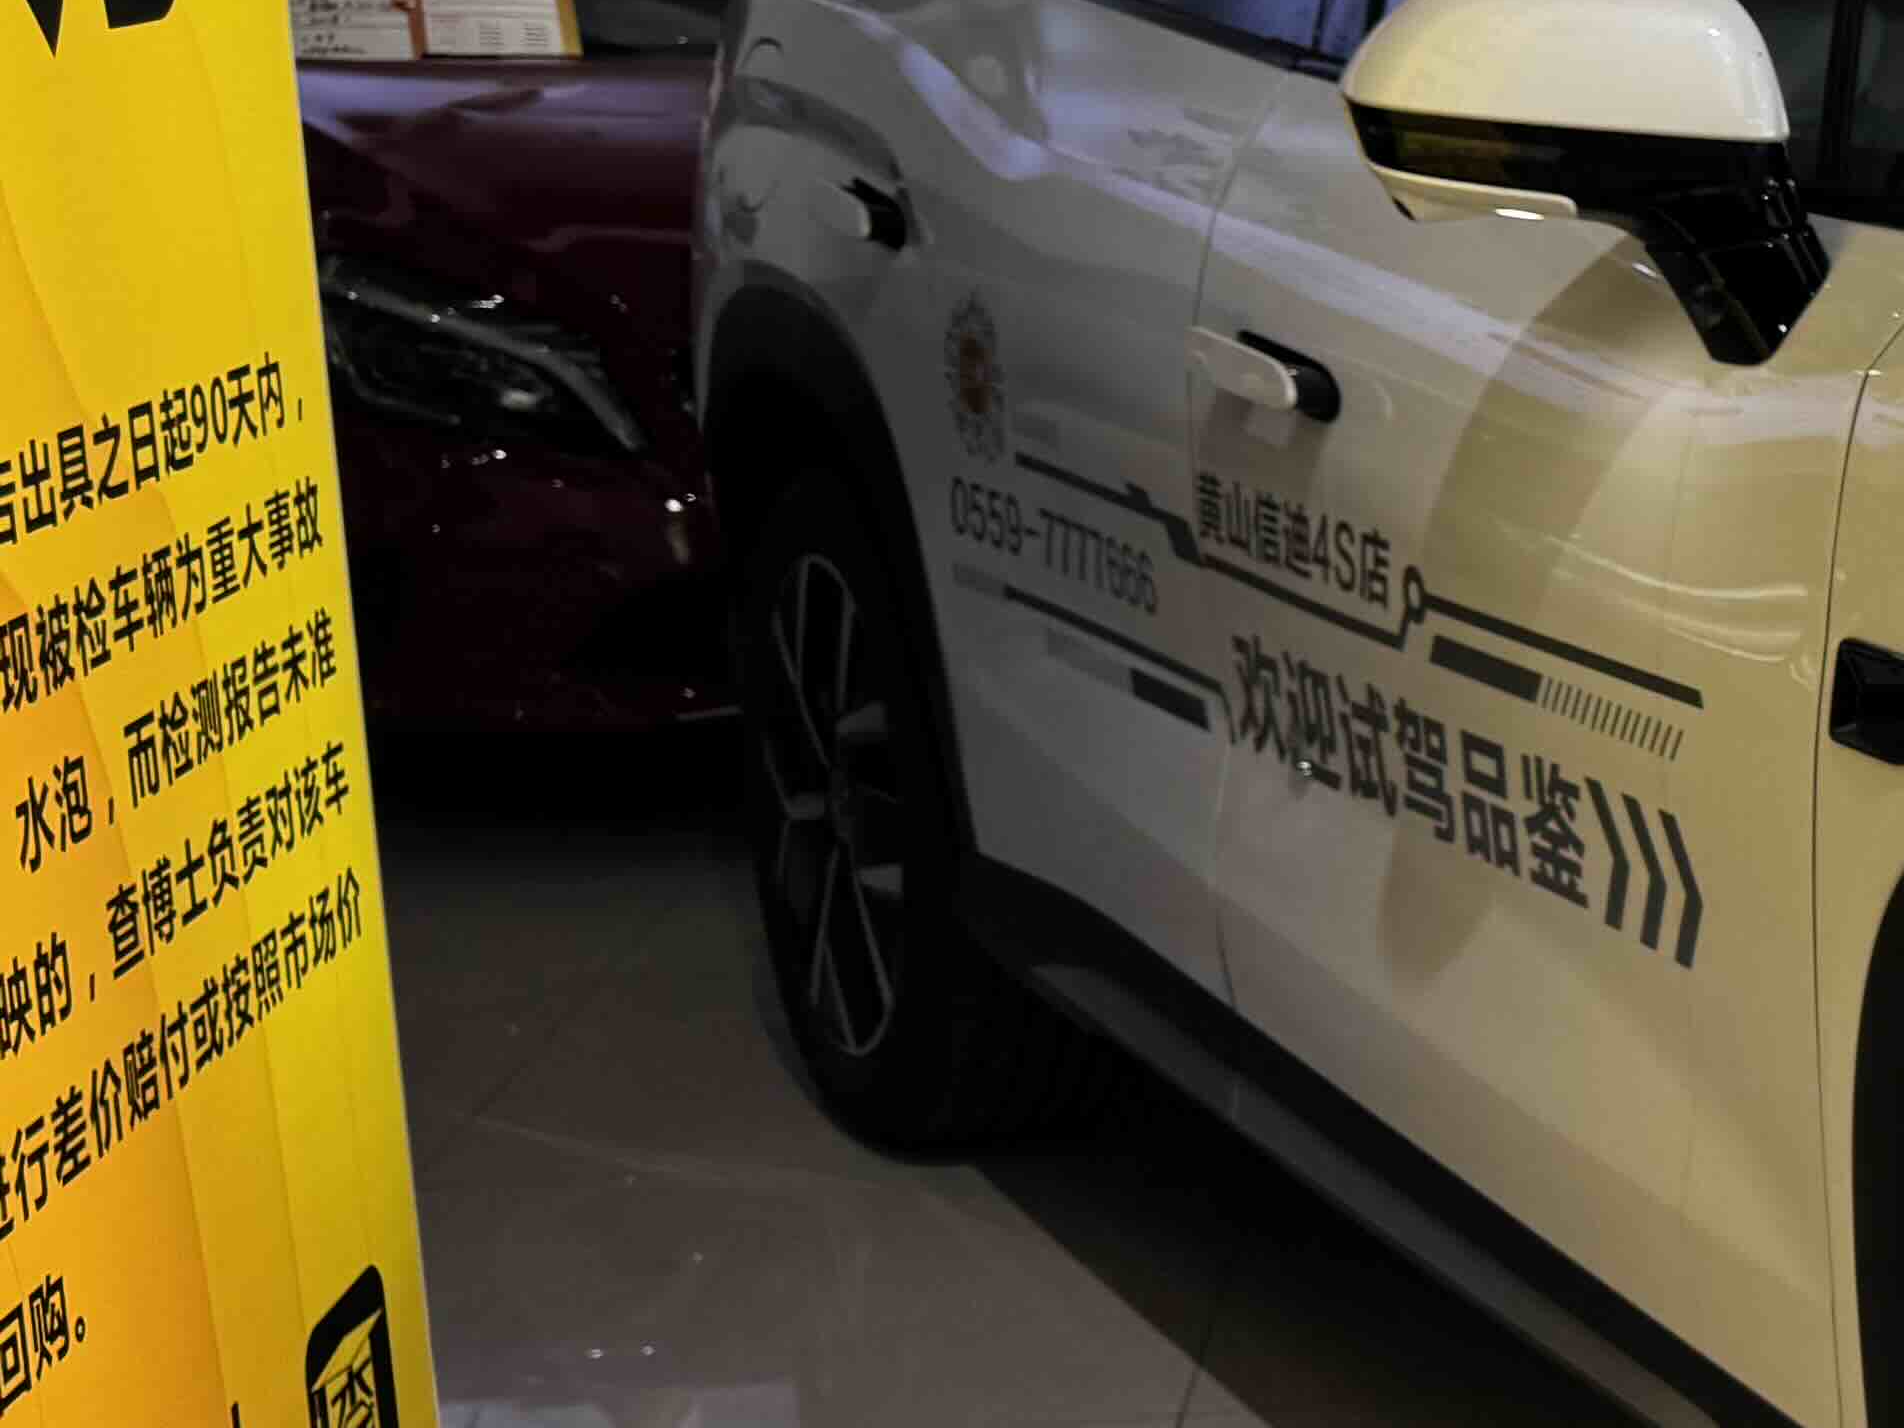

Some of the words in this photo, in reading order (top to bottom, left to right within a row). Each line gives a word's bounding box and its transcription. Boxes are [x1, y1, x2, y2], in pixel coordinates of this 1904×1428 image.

[1231, 633, 1590, 909] 欢迎试驾品鉴
